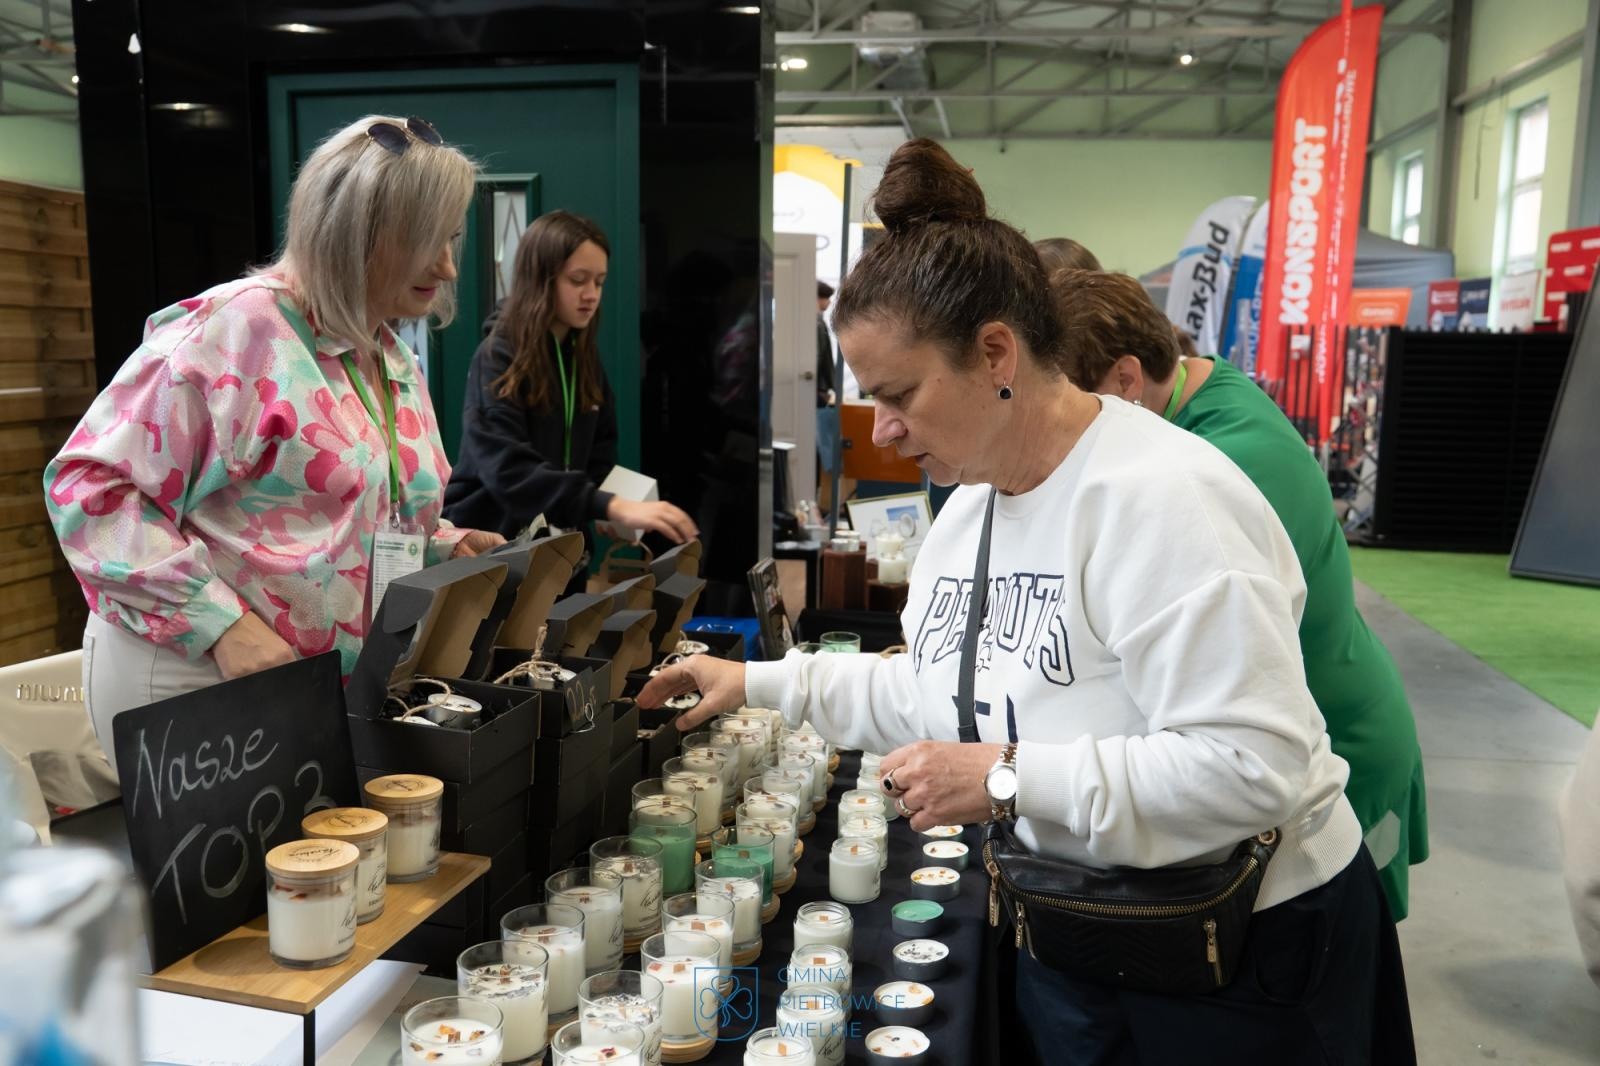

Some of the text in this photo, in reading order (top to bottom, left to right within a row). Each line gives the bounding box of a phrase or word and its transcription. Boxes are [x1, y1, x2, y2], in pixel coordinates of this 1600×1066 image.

[1186, 221, 1230, 342] ax-Bud
[1279, 119, 1327, 325] KONSPORT
[131, 719, 280, 819] Nasze
[151, 784, 286, 926] TOP
